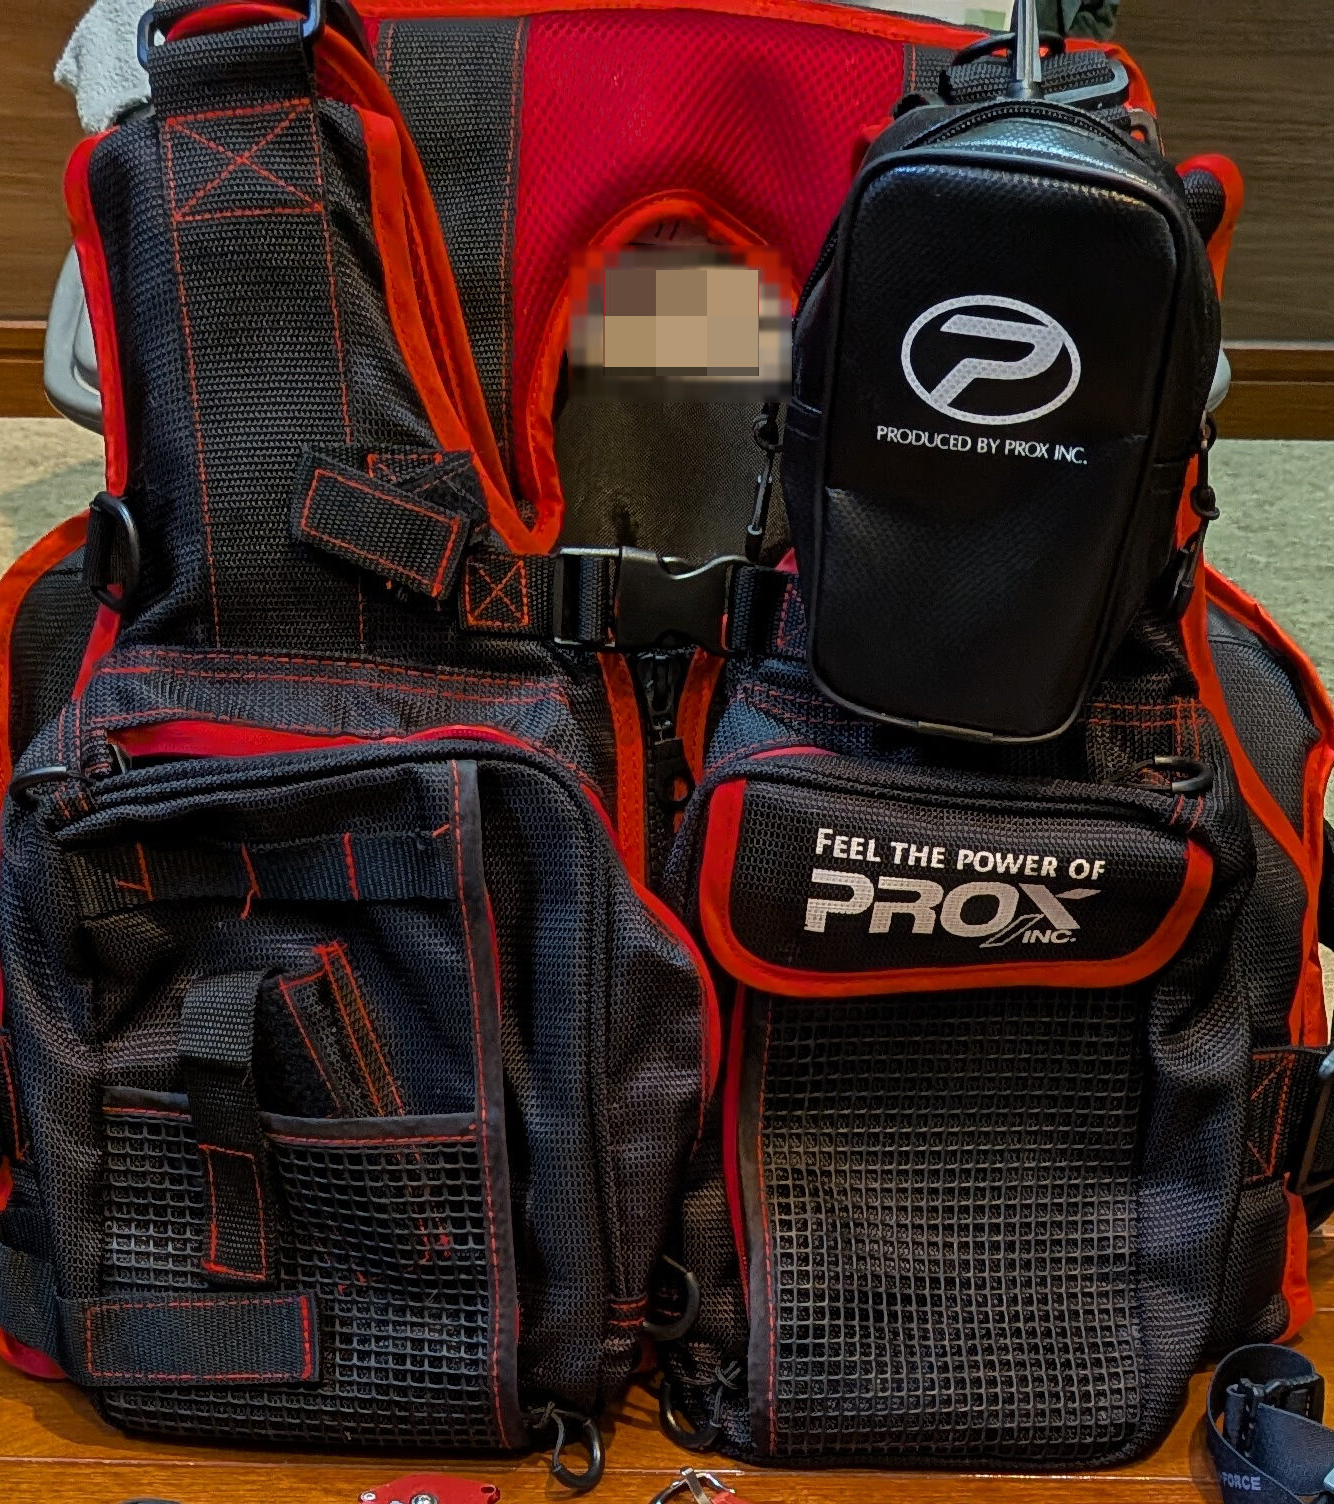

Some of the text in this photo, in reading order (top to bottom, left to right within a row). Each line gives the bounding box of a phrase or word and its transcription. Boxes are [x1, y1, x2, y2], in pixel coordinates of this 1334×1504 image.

[876, 425, 1088, 464] PRODUCED BY PROX INC.
[815, 828, 1106, 880] FEEL THE POWER OF
[804, 868, 1102, 948] PROX
[1021, 929, 1077, 944] INC.
